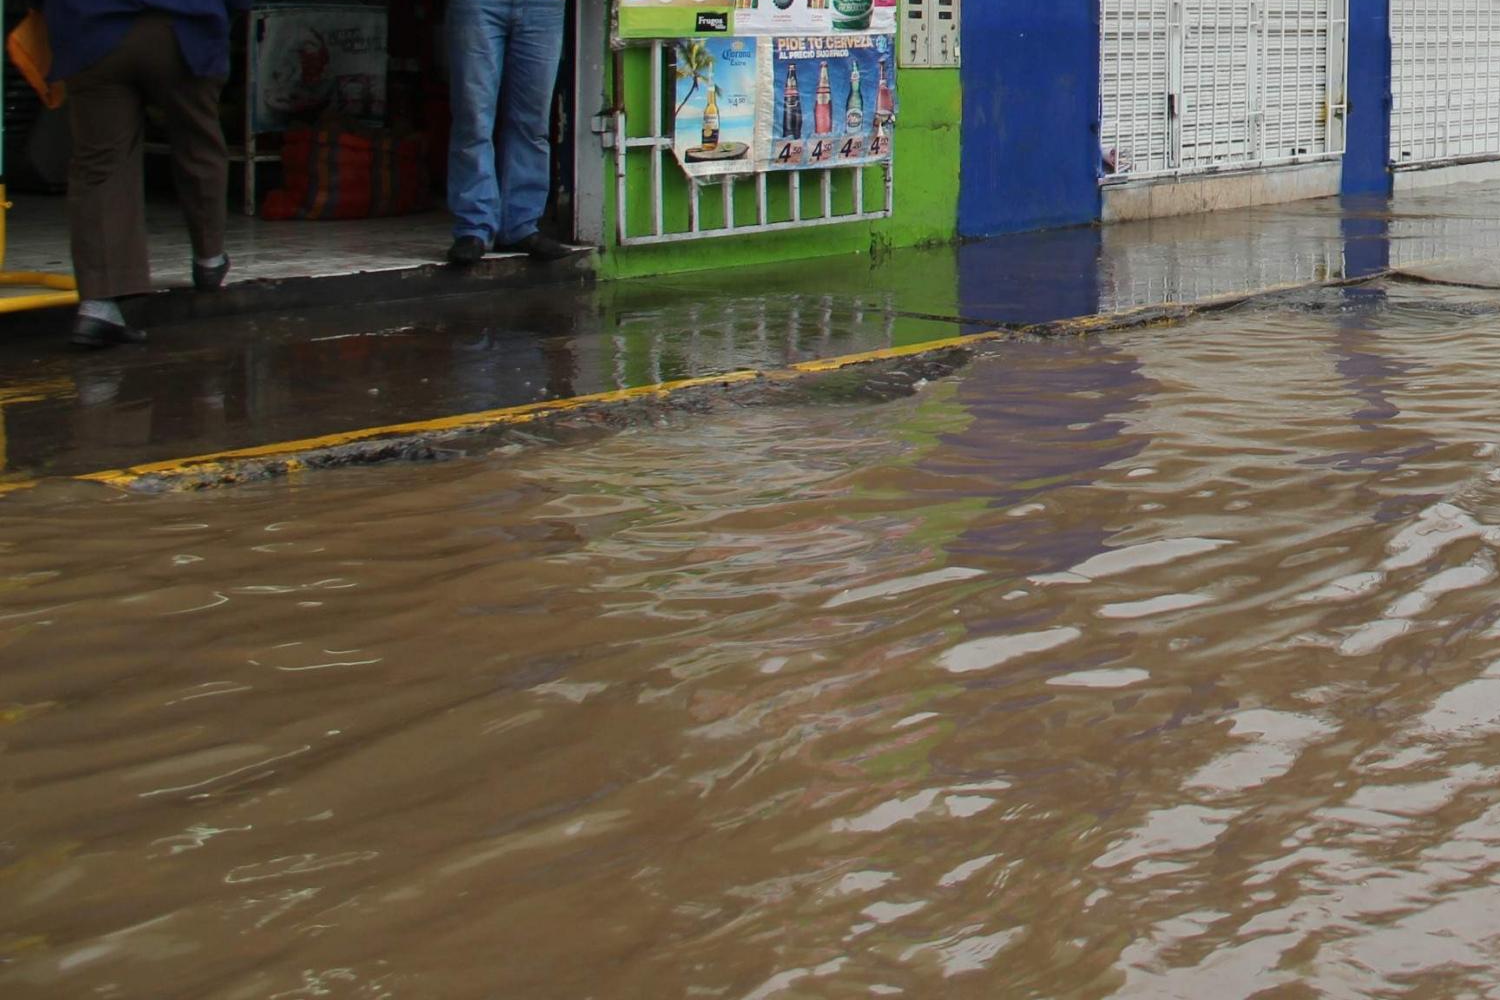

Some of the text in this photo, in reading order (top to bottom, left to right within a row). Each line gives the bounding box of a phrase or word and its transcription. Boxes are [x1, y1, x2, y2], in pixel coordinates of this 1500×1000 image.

[698, 15, 723, 28] Frugos
[778, 35, 874, 51] PIDE TU CERVEZA
[721, 49, 752, 62] Corona
[779, 50, 790, 60] AL
[790, 49, 815, 59] PRECIO
